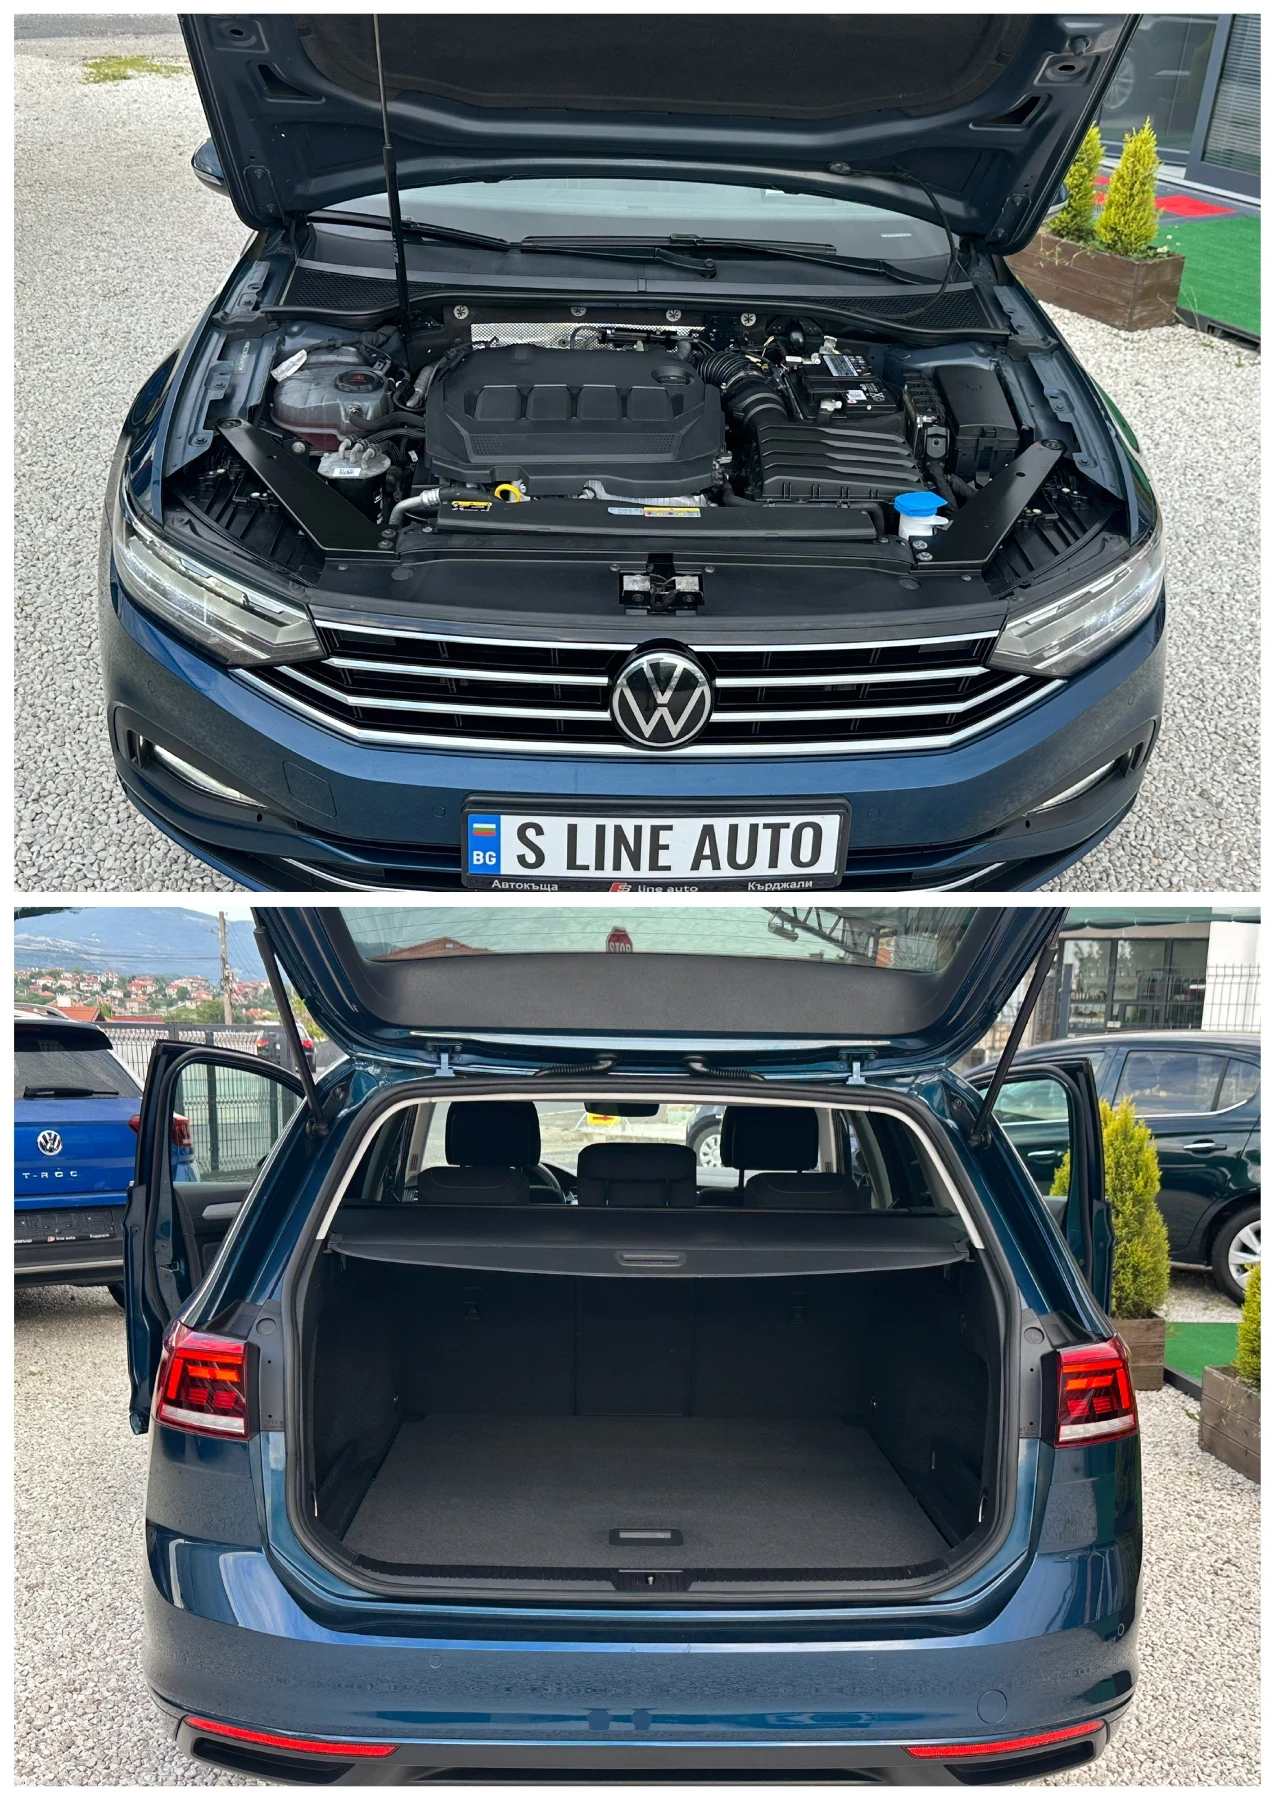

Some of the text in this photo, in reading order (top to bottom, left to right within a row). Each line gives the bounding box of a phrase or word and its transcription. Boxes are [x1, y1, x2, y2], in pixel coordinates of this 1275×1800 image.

[516, 821, 824, 872] S LINE AUTO
[472, 850, 497, 865] BG
[491, 879, 559, 892] Автокъща
[637, 884, 663, 893] line
[666, 885, 699, 893] auto
[747, 879, 813, 892] Кърджали
[609, 942, 631, 952] STOP
